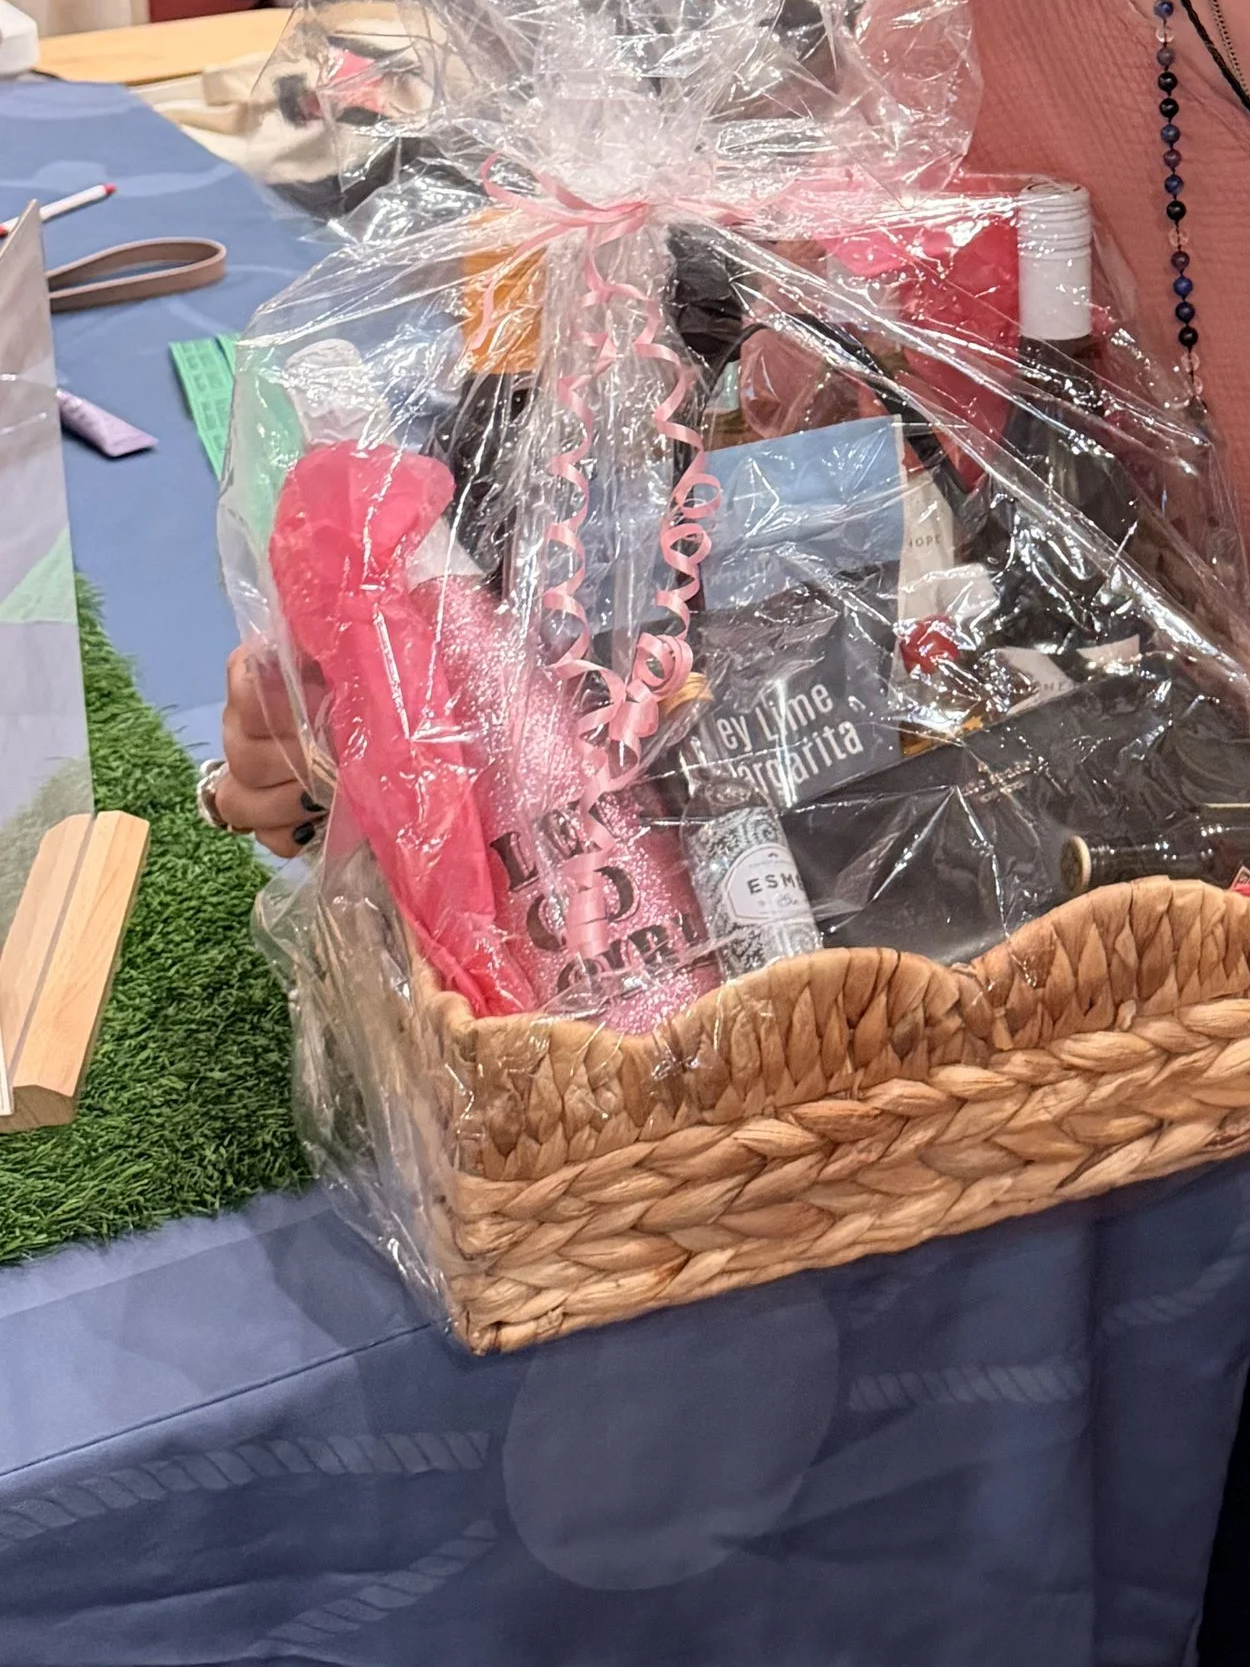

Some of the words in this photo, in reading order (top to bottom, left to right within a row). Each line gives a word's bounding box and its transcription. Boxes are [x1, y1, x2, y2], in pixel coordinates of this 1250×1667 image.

[713, 715, 753, 753] ey
[754, 683, 834, 742] Lime
[727, 720, 865, 796] argarita
